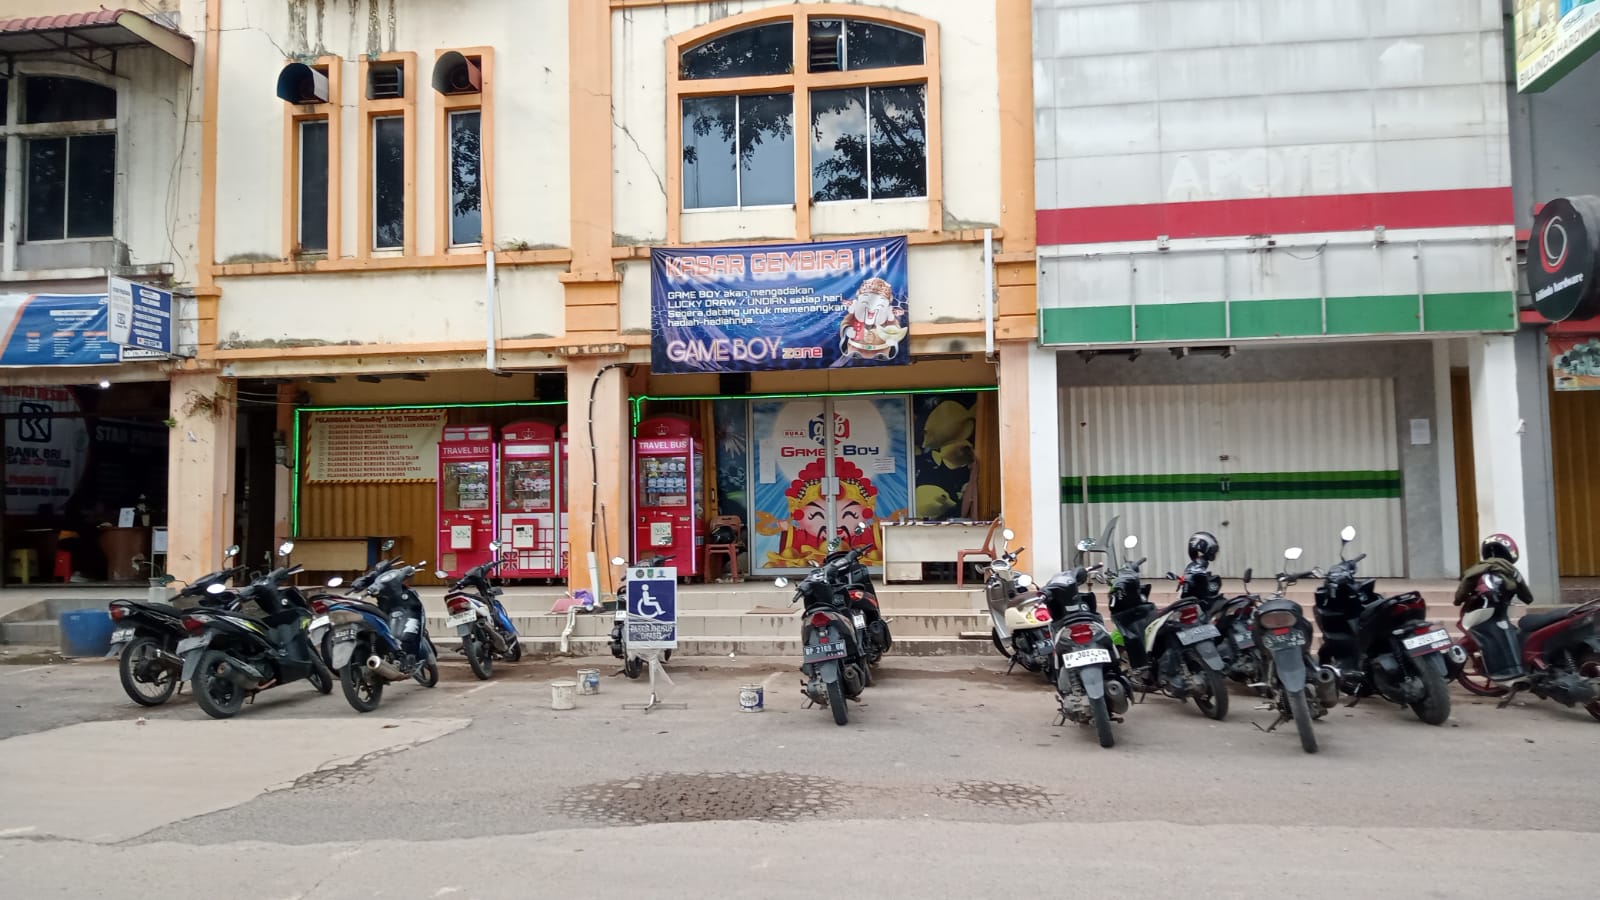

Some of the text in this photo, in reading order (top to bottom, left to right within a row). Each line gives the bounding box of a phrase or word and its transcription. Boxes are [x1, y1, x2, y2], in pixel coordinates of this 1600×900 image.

[665, 254, 744, 276] KABAR
[751, 249, 853, 273] GEMBIRA
[668, 286, 814, 300] GAME BOY akan mengadakan
[668, 300, 704, 309] LUCKY
[705, 299, 737, 308] DRAW
[747, 297, 787, 306] UNDIAN
[790, 296, 821, 306] setiap
[823, 293, 843, 303] hari
[668, 303, 847, 320] Segera datang untuk memenangkan
[666, 336, 822, 362] GAME BOY zone
[443, 446, 489, 455] TRAVEL BUS
[639, 439, 687, 449] TRAVEL BUS
[6, 446, 61, 459] BANK BRI
